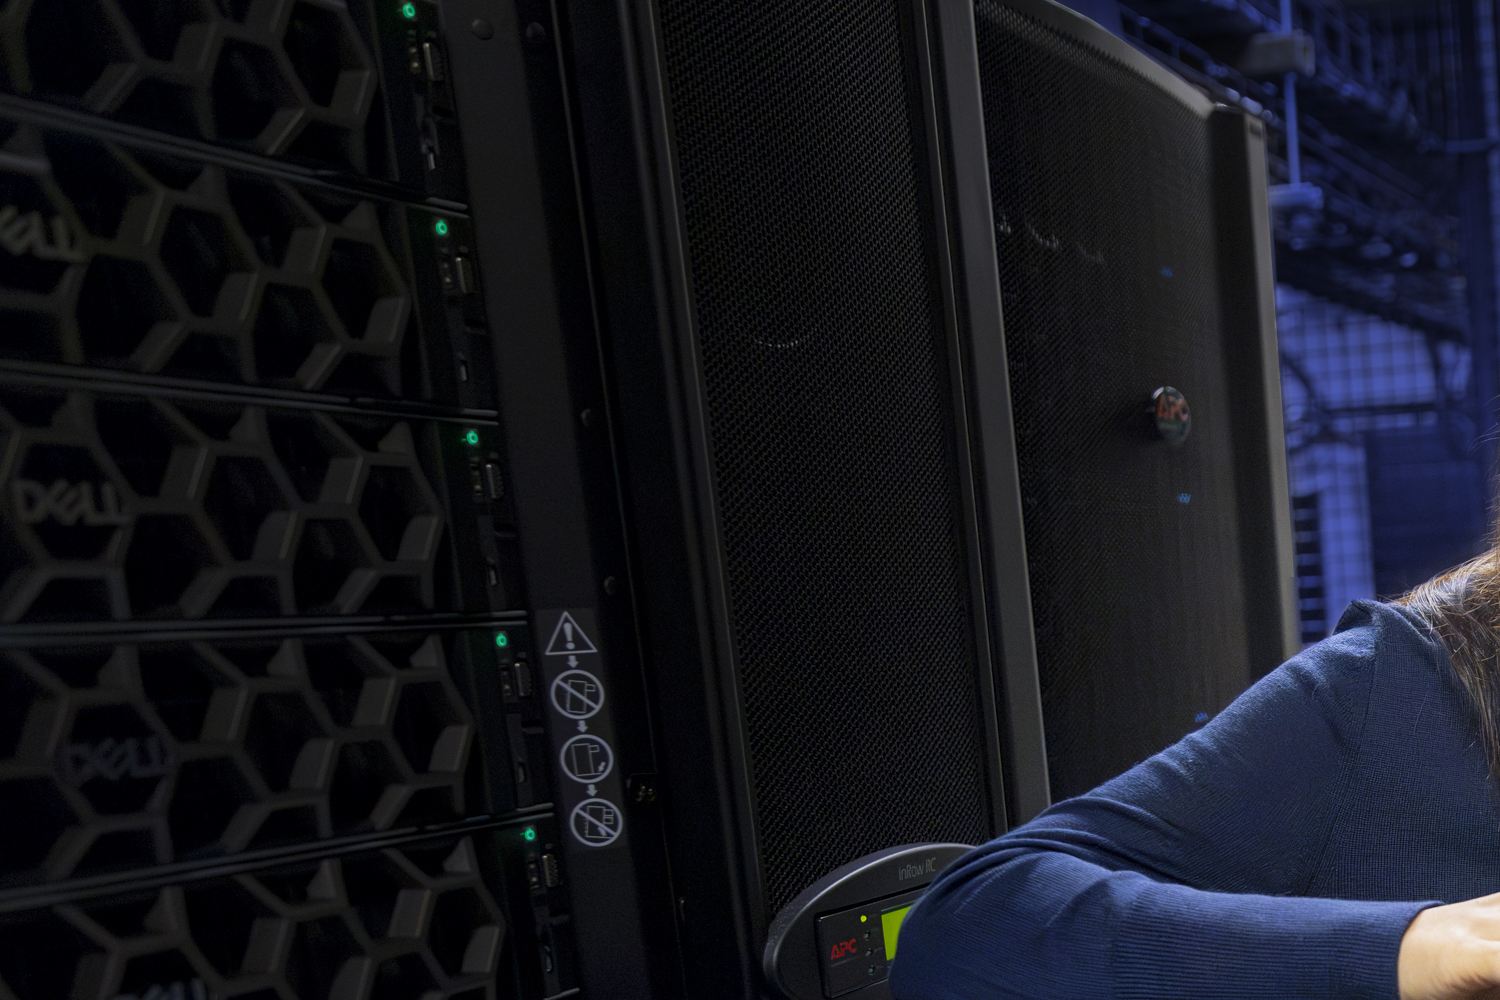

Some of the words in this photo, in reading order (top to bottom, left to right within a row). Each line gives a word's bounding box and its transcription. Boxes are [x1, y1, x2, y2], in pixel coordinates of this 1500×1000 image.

[0, 204, 85, 262] ELL
[13, 477, 131, 526] DELL
[60, 736, 172, 786] DELL
[925, 857, 936, 873] RC
[830, 938, 857, 960] APC
